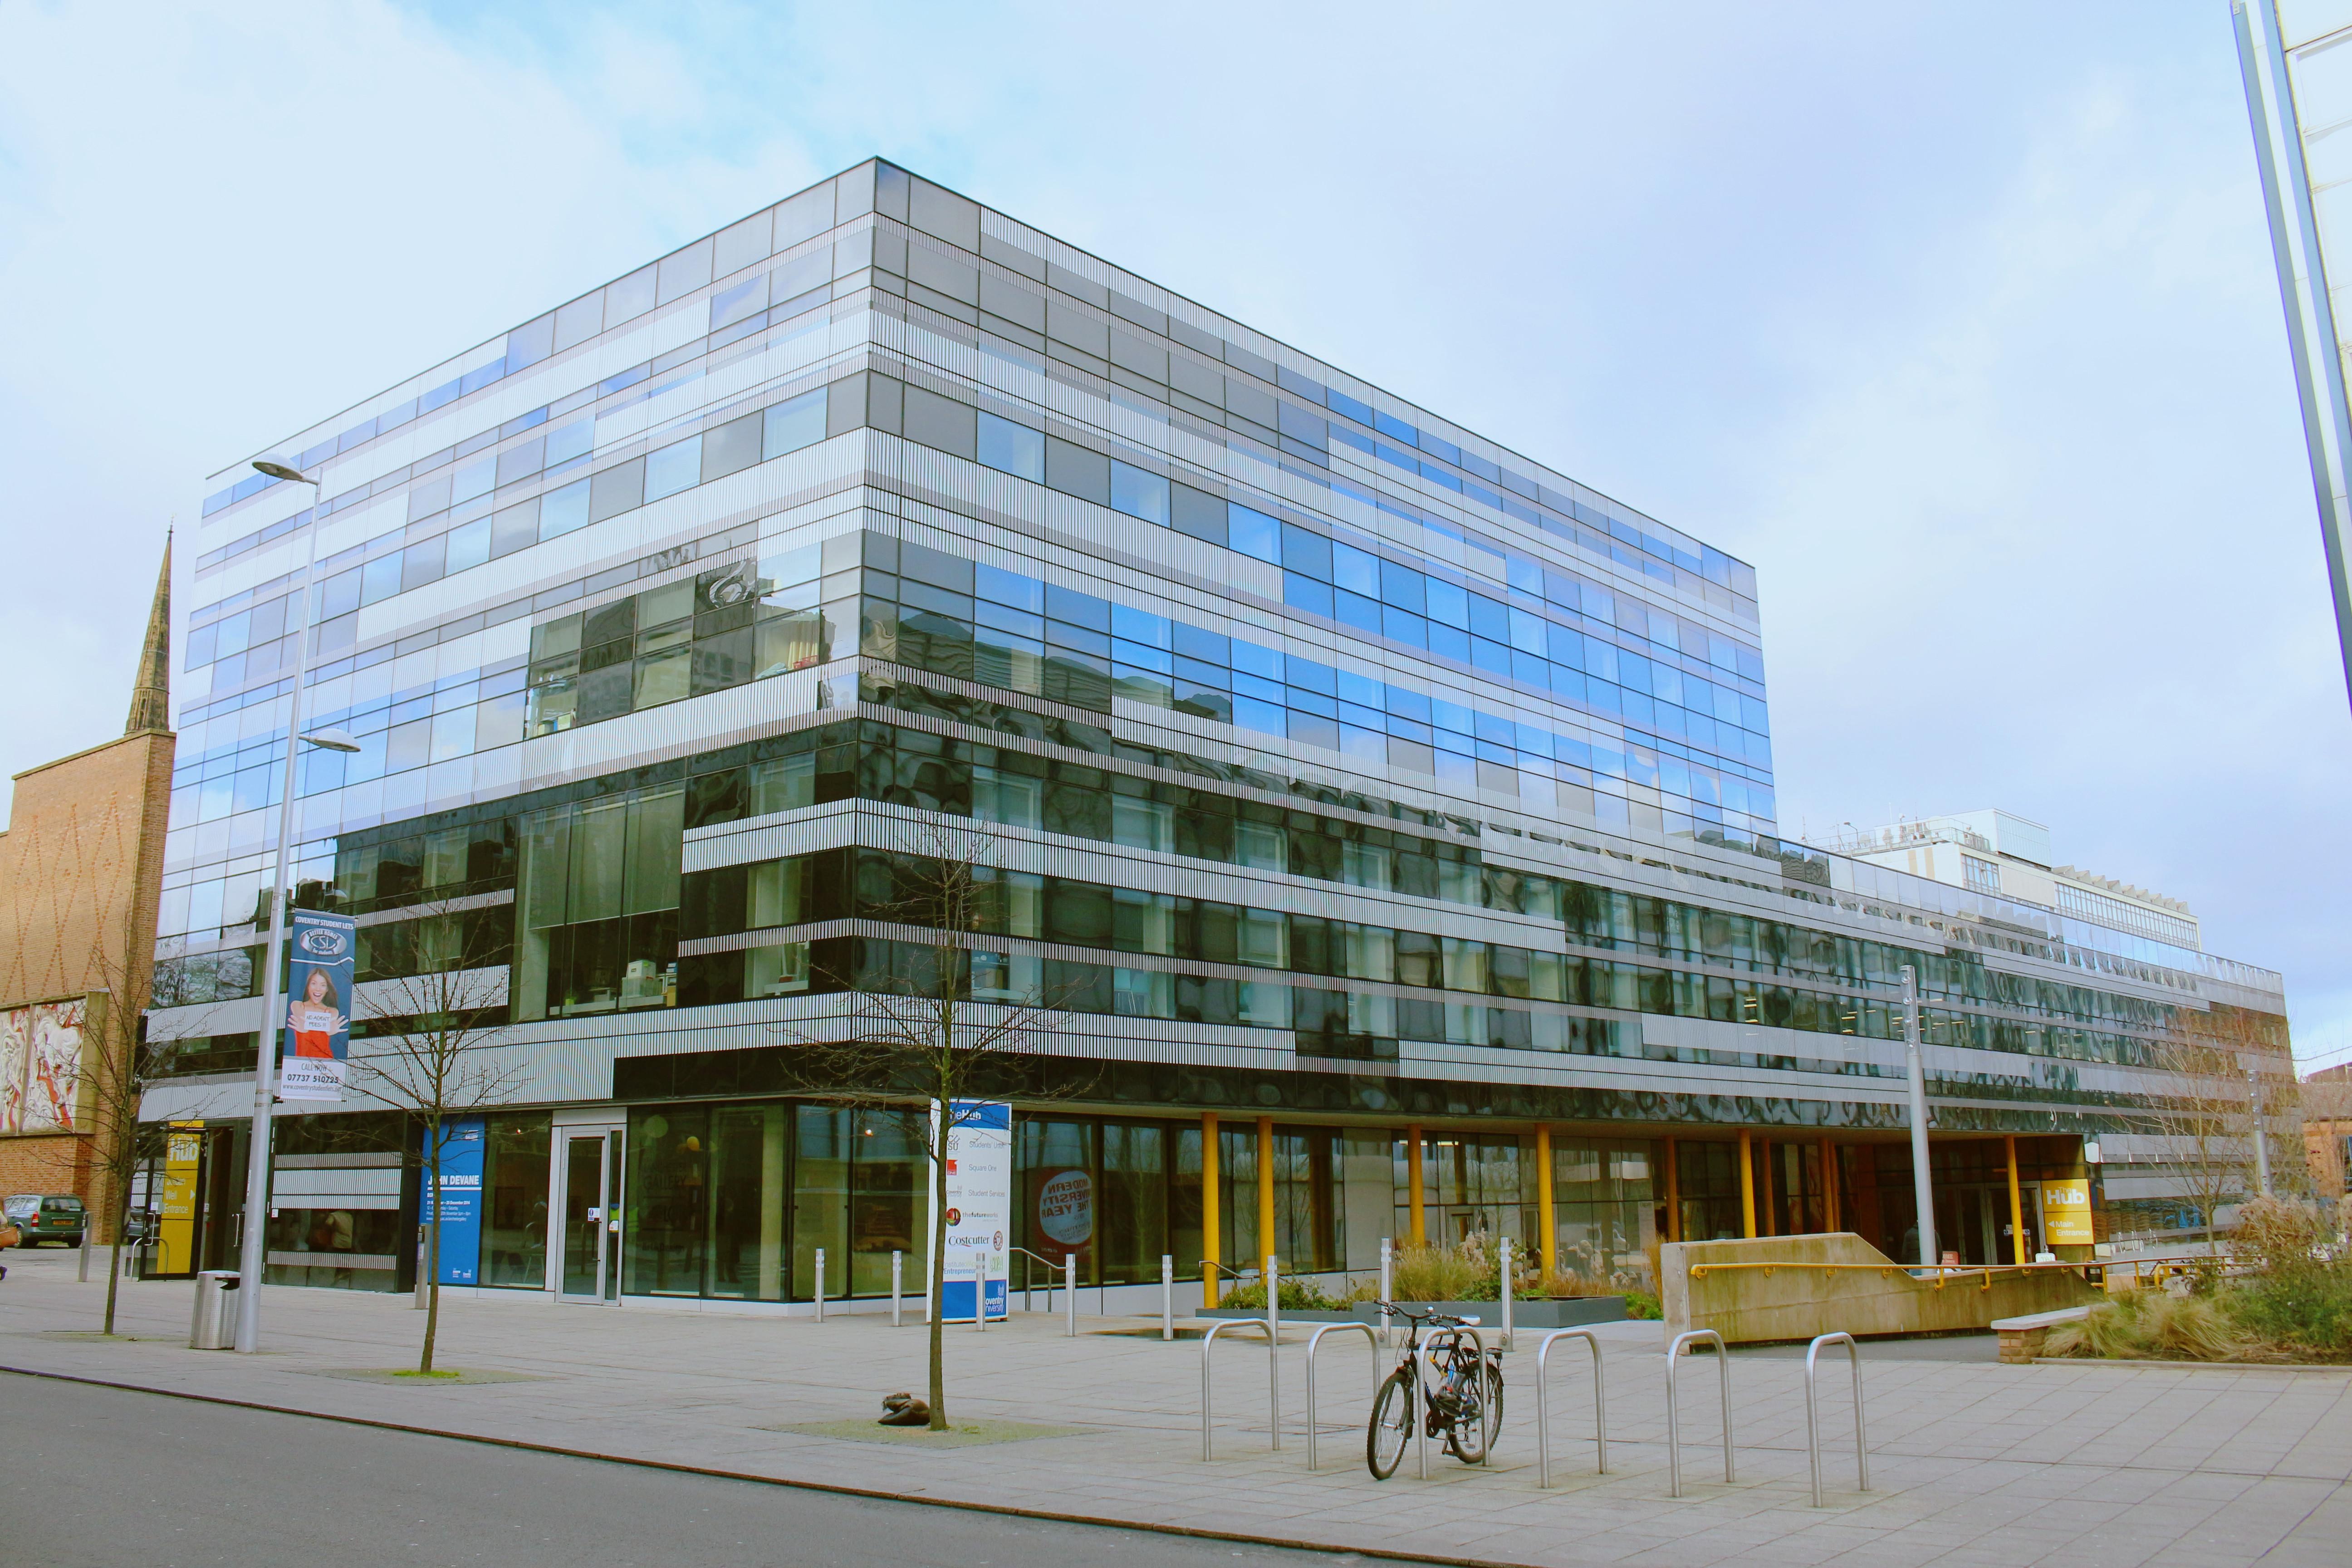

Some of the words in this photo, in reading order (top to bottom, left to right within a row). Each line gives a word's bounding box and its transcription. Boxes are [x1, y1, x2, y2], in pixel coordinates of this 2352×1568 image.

[295, 916, 320, 925] COVENTRY
[319, 920, 342, 928] STUDENT
[324, 930, 338, 940] HOMES
[310, 935, 336, 949] CSL
[301, 1063, 313, 1071] CALL
[287, 1073, 310, 1082] 07737
[313, 1075, 339, 1083] 510725
[170, 1137, 198, 1161] Hub
[969, 1164, 987, 1172] Square
[428, 1175, 448, 1185] JHN
[450, 1175, 480, 1185] DEVANE
[166, 1190, 177, 1200] Well
[2046, 1188, 2085, 1205] Hub
[164, 1203, 189, 1214] Entrance
[949, 1235, 990, 1246] Costcutter
[985, 1296, 1004, 1305] oventry
[985, 1304, 1004, 1313] niversity
